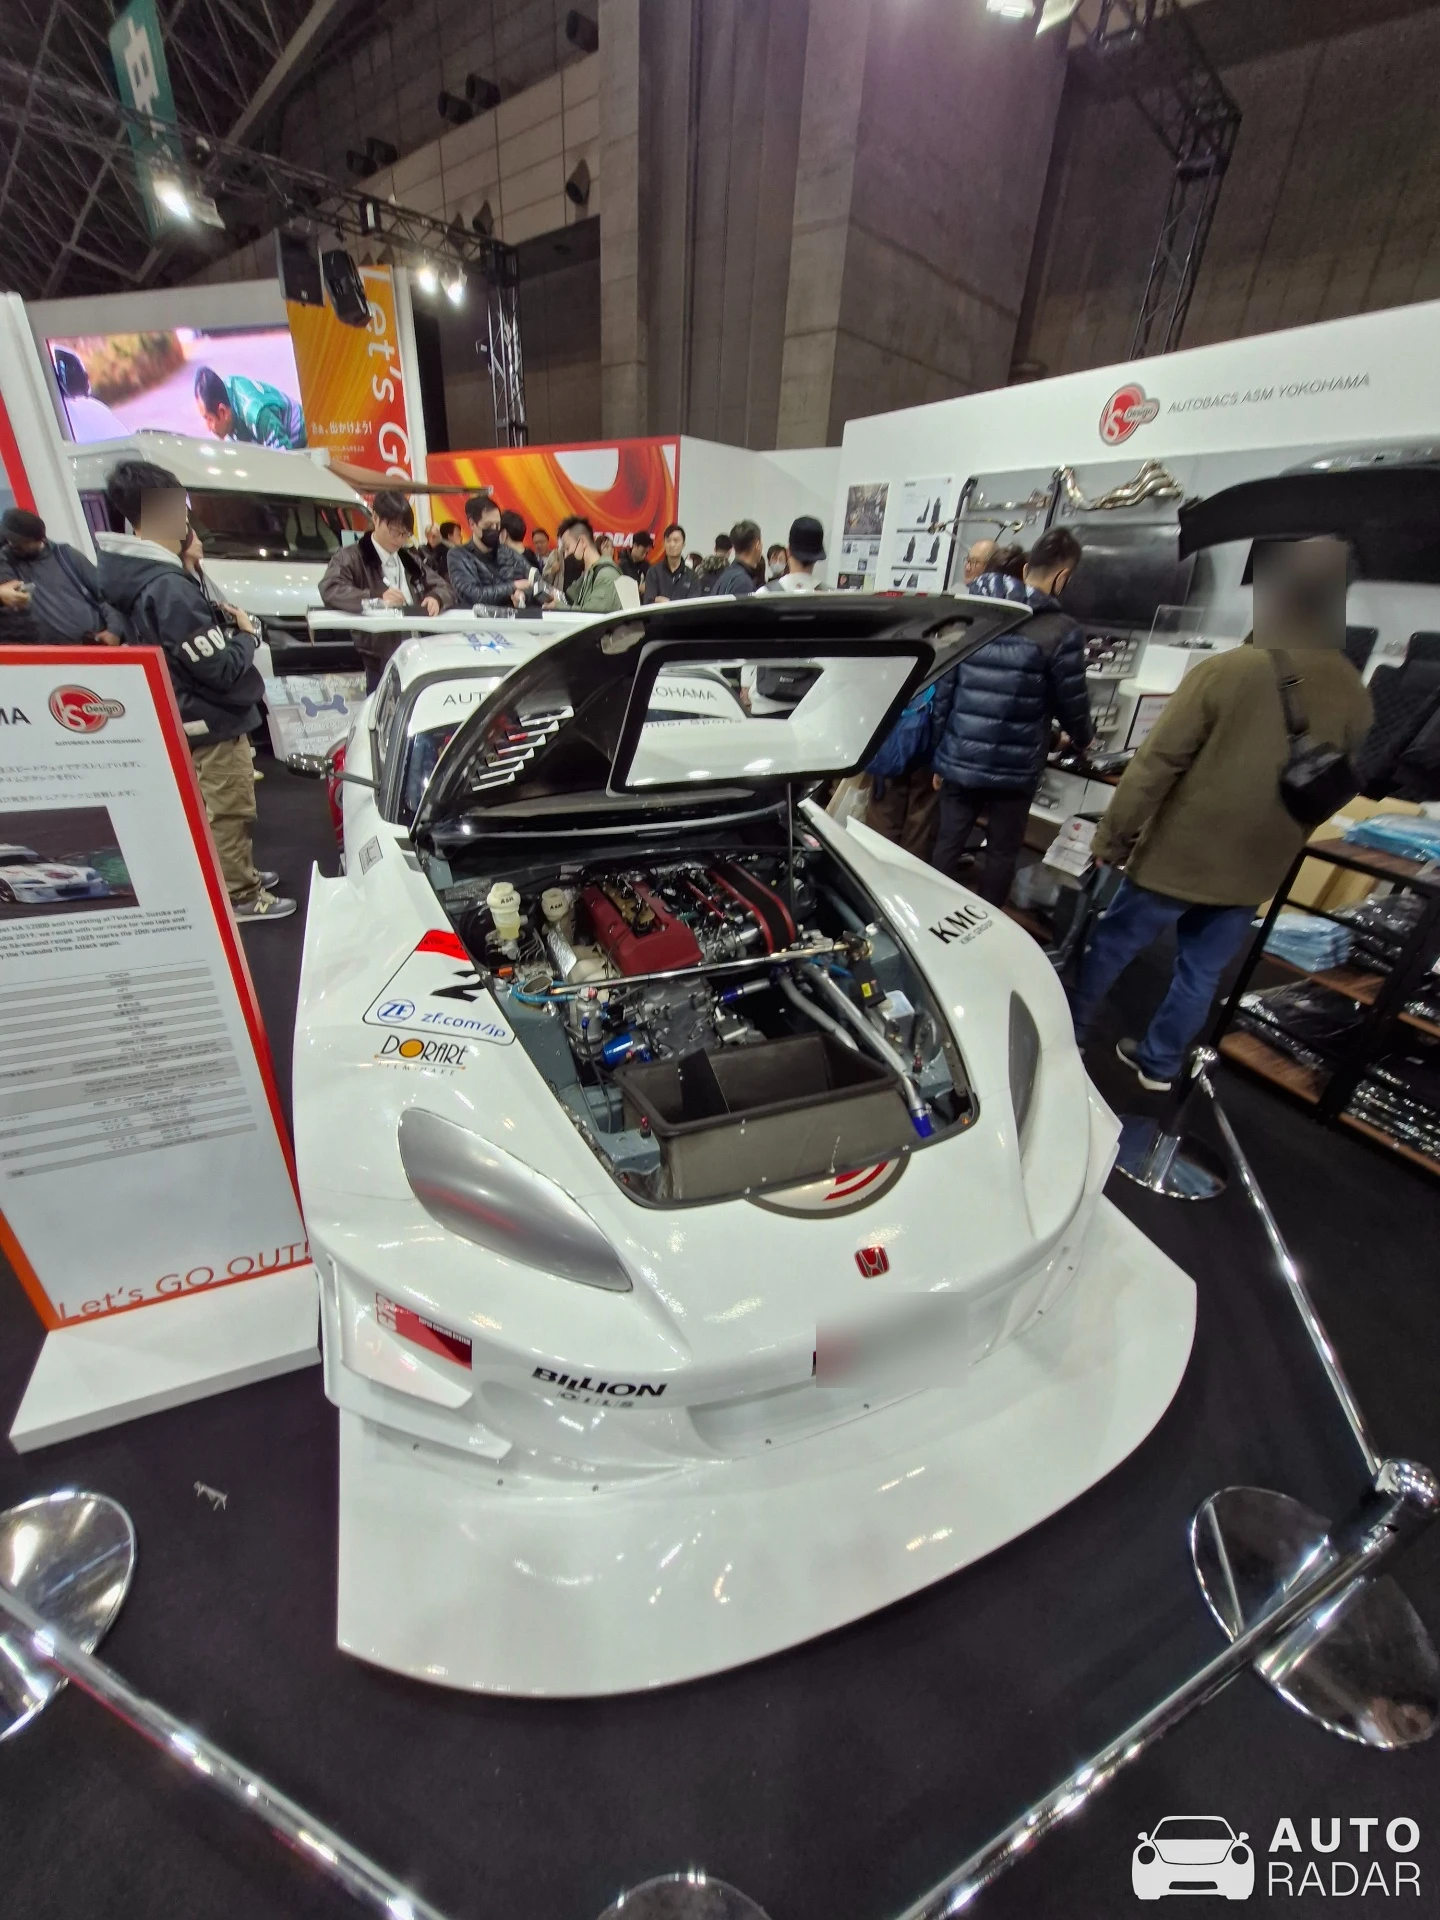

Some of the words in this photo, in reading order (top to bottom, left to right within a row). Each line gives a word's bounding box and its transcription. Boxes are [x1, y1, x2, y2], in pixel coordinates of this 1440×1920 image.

[1166, 392, 1239, 414] AUTOBACS
[1240, 385, 1275, 404] ASM
[1280, 372, 1369, 398] YOKOHAMA
[84, 702, 119, 714] Design
[442, 691, 488, 706] AUT
[652, 684, 719, 702] OHAMA
[928, 904, 988, 944] KMC
[421, 1012, 507, 1038] zf.com/jp
[57, 1286, 144, 1322] Let's
[155, 1266, 214, 1295] GO
[227, 1241, 311, 1277] OUT!
[532, 1366, 668, 1398] BILLION
